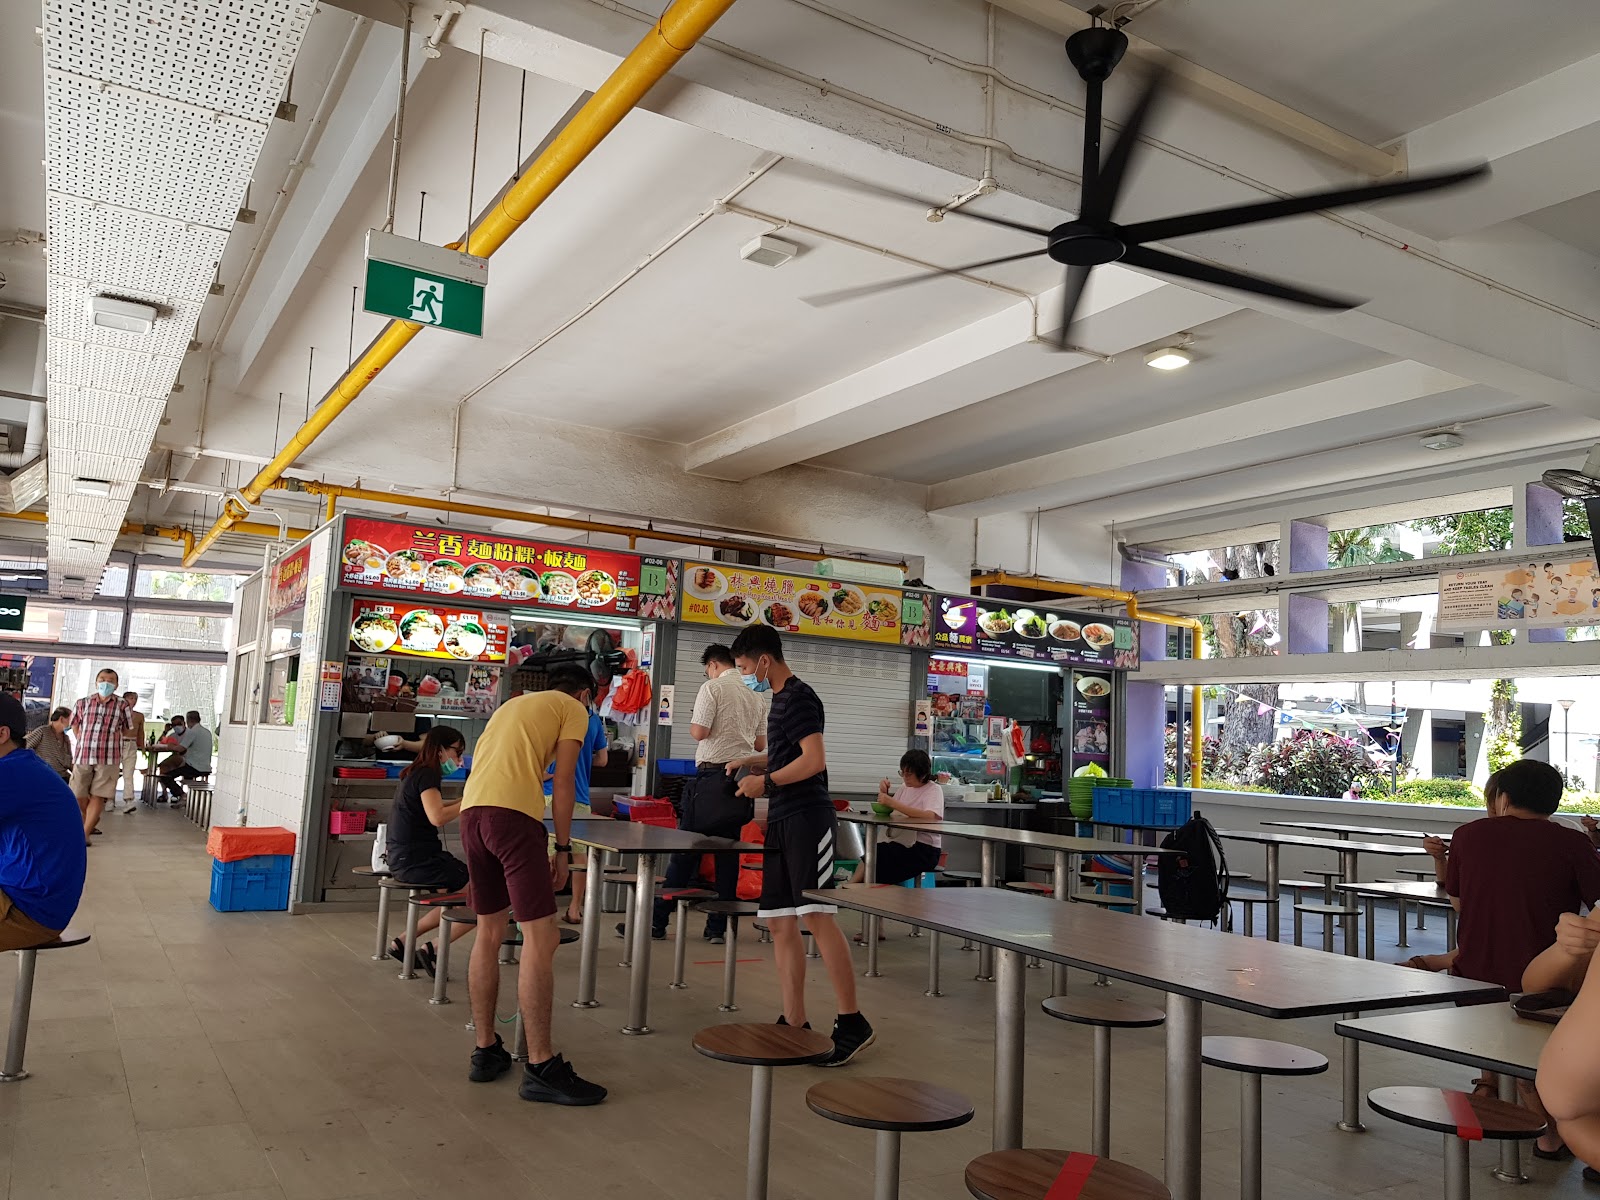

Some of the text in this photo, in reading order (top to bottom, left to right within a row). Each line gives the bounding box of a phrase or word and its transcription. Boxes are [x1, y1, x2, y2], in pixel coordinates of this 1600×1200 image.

[411, 530, 464, 556] 兰香
[644, 558, 663, 566] #02-06
[648, 573, 659, 587] B
[688, 603, 709, 614] #02-05
